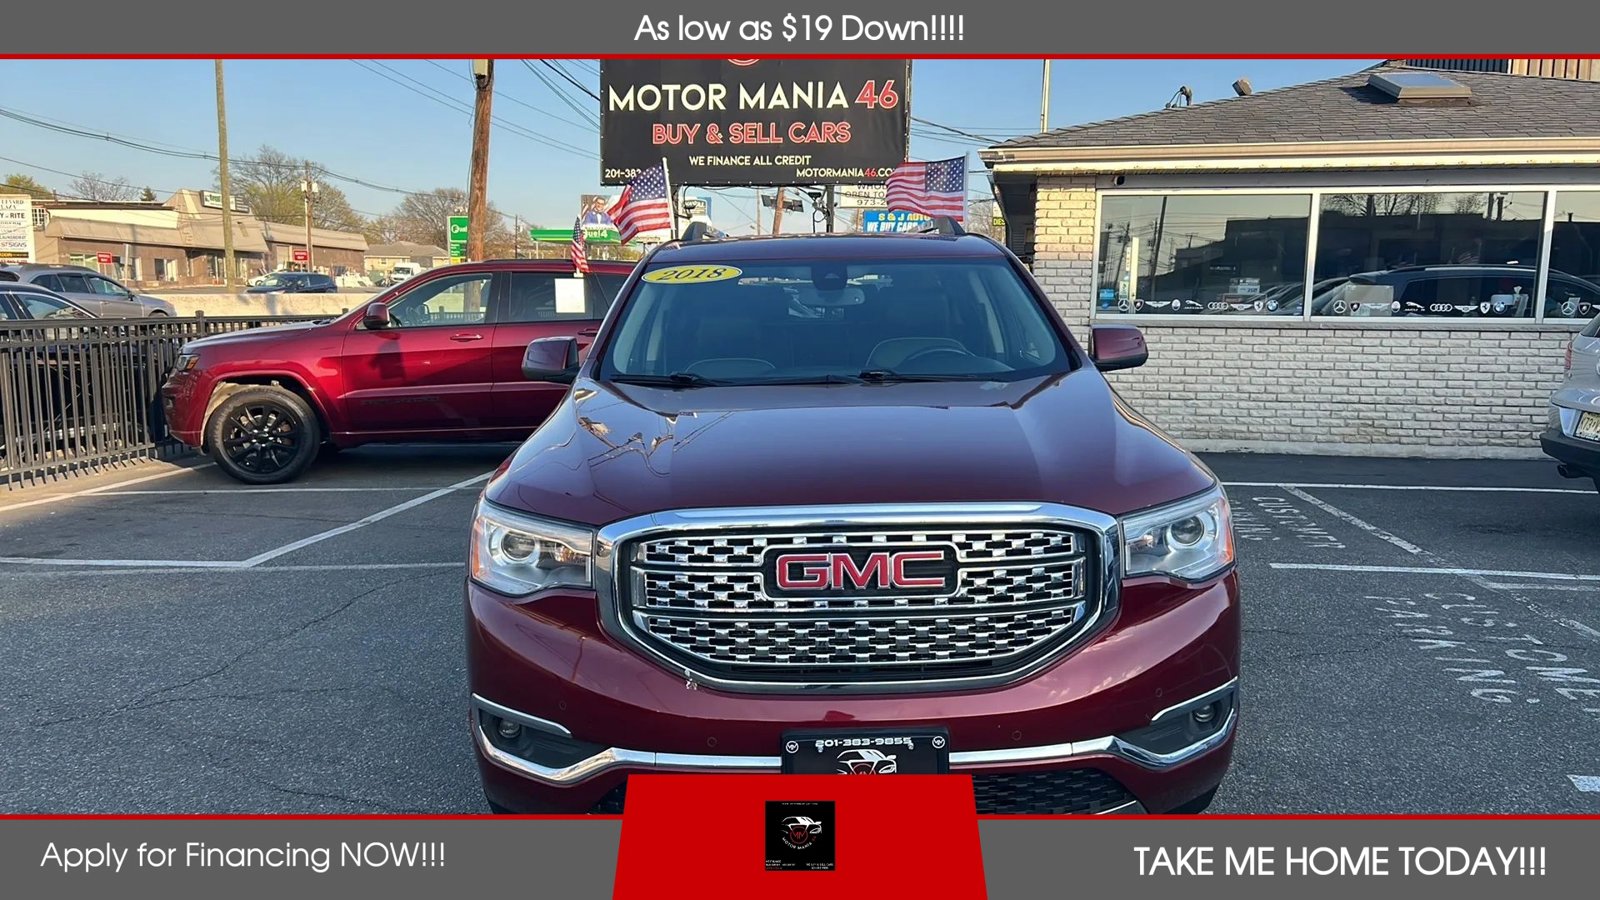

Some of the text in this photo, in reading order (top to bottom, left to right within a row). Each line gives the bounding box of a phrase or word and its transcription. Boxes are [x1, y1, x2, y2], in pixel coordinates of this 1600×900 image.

[608, 79, 899, 111] MOTOR MANIA 46
[652, 121, 851, 145] BUY & SELL CARS
[689, 154, 812, 166] WE FINANCE ALL CREDIT
[796, 167, 895, 178] MOTORMANIA46.CO
[856, 199, 887, 207] 973-2
[656, 267, 727, 281] 2018
[776, 551, 946, 590] GMC
[815, 736, 913, 748] 201-383-9855
